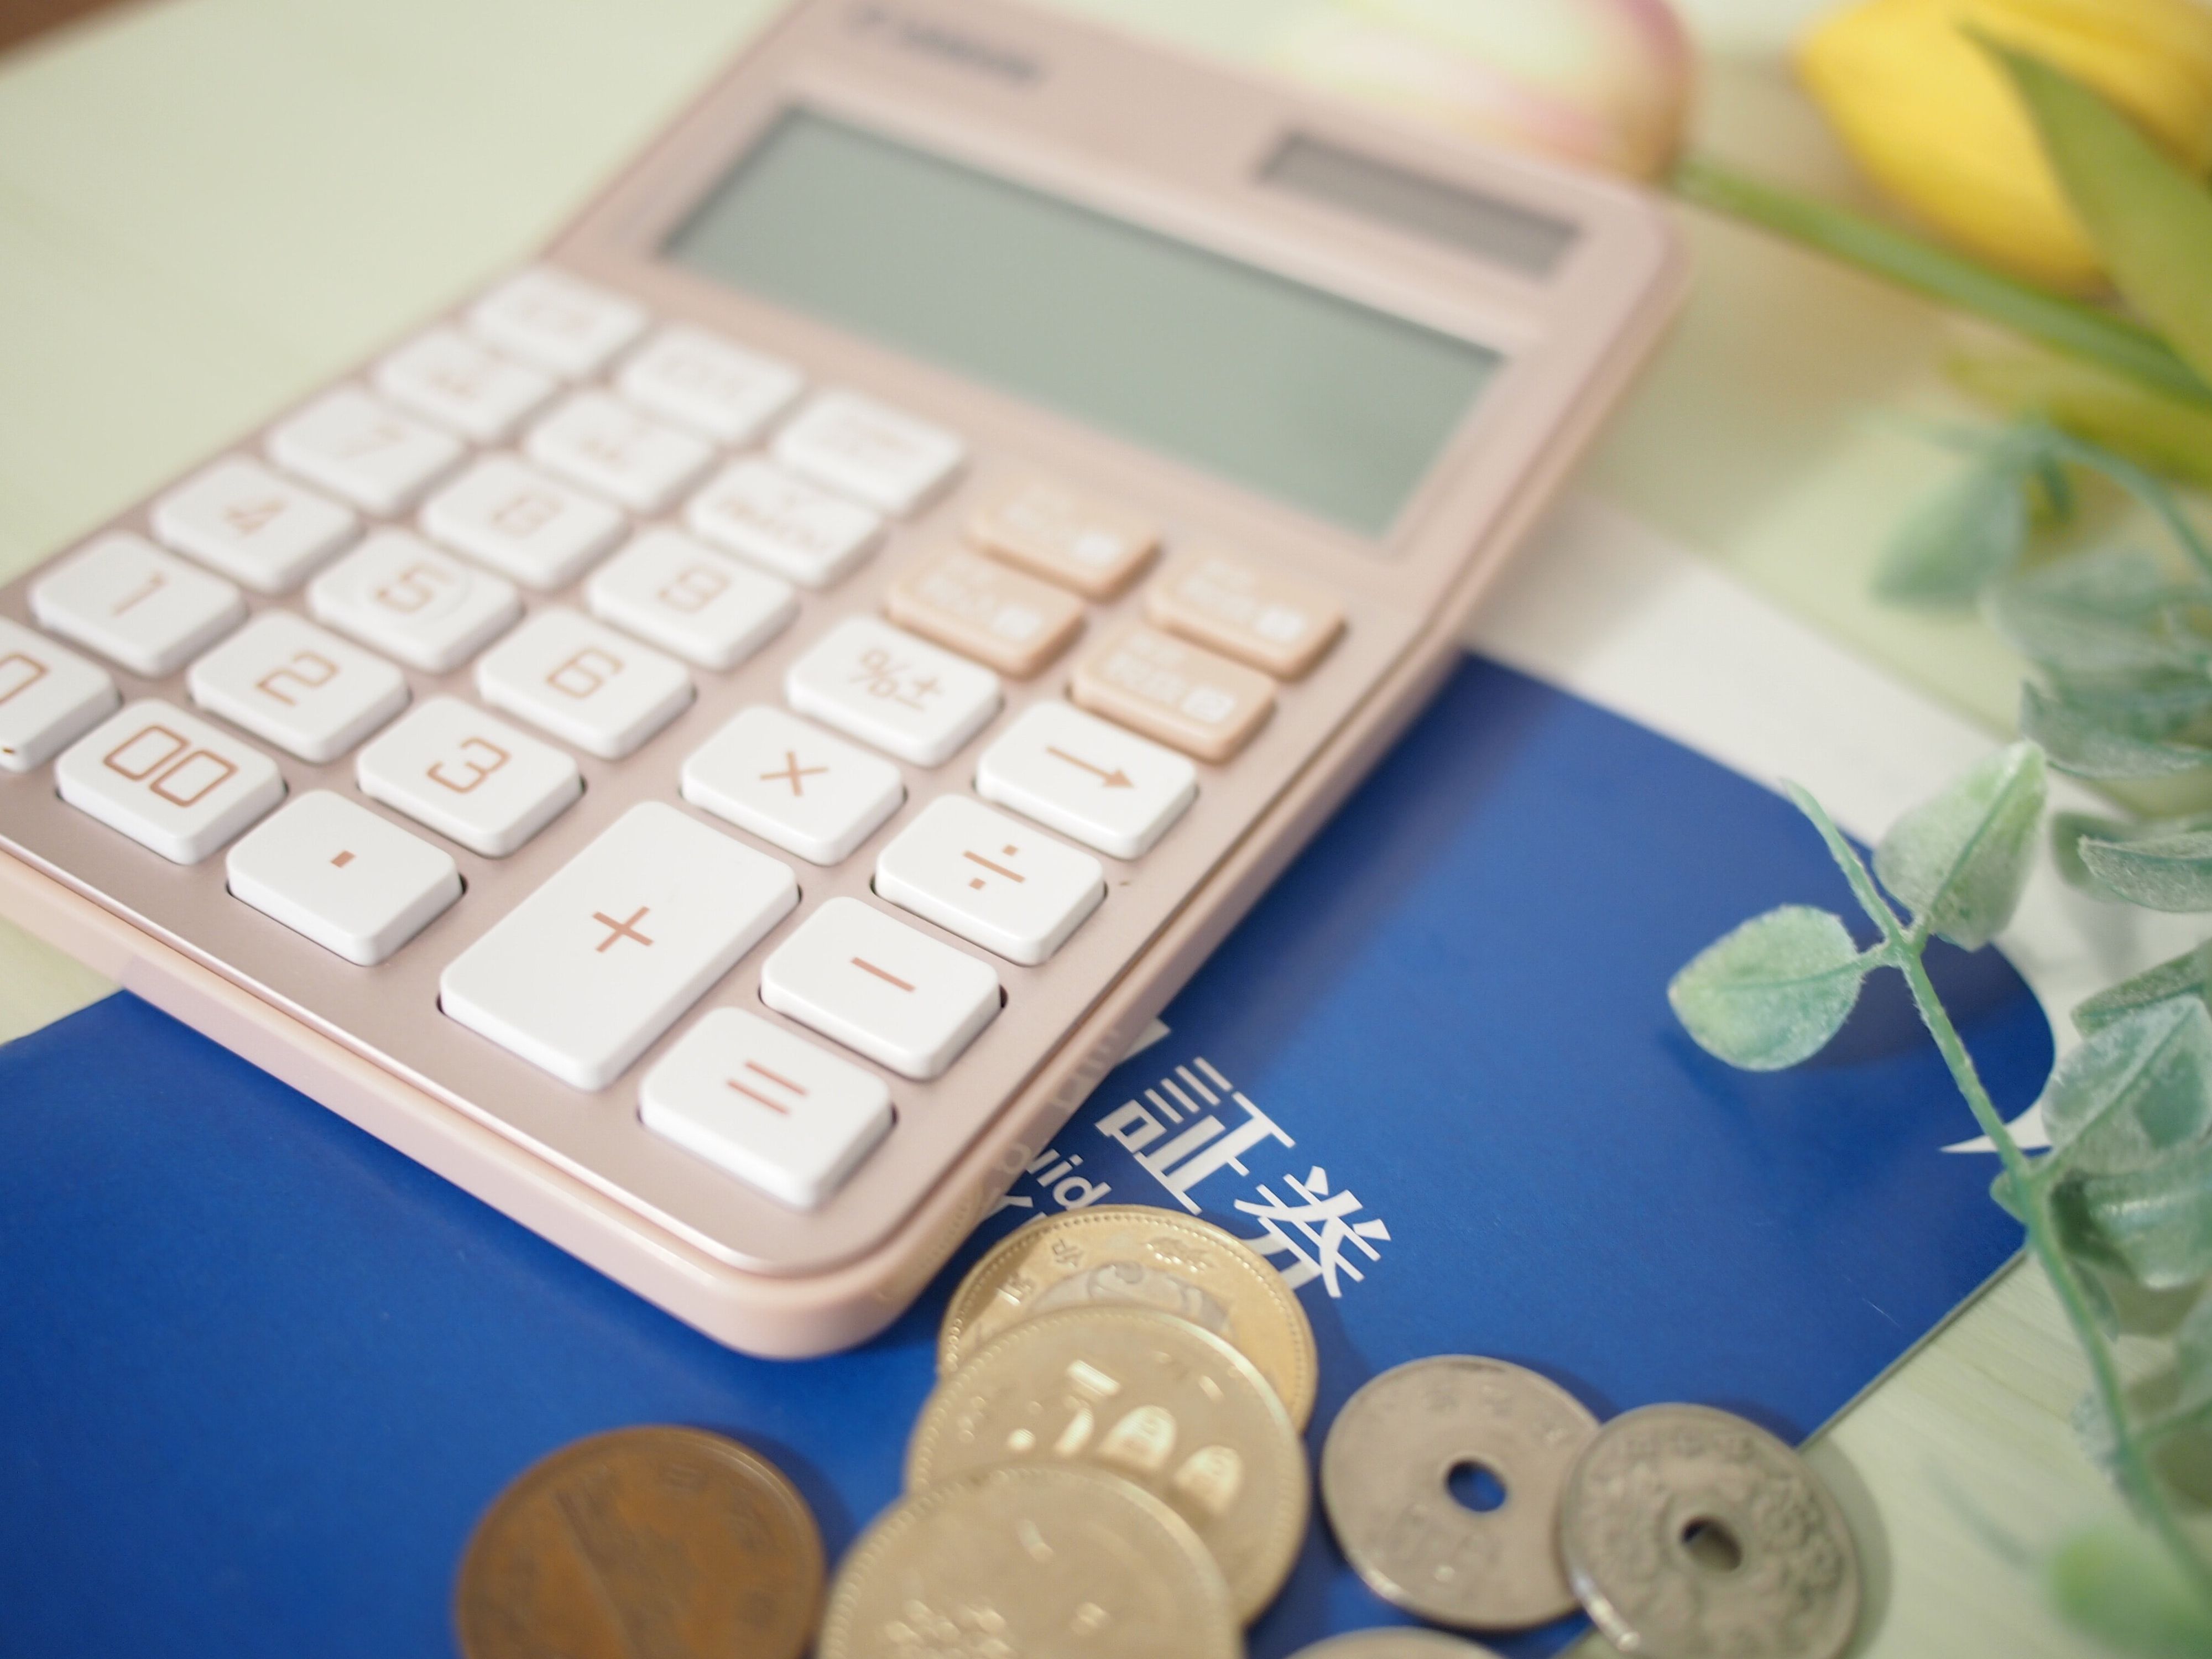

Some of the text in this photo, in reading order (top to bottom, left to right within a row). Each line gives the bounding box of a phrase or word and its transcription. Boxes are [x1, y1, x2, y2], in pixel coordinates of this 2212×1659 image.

[223, 495, 290, 537] 4
[112, 570, 169, 617] 1
[373, 560, 452, 613] 5
[254, 650, 343, 707] 2
[545, 645, 625, 701] 6
[102, 724, 239, 808] 00
[427, 737, 512, 795] 3
[1095, 1019, 1392, 1298] 証券
